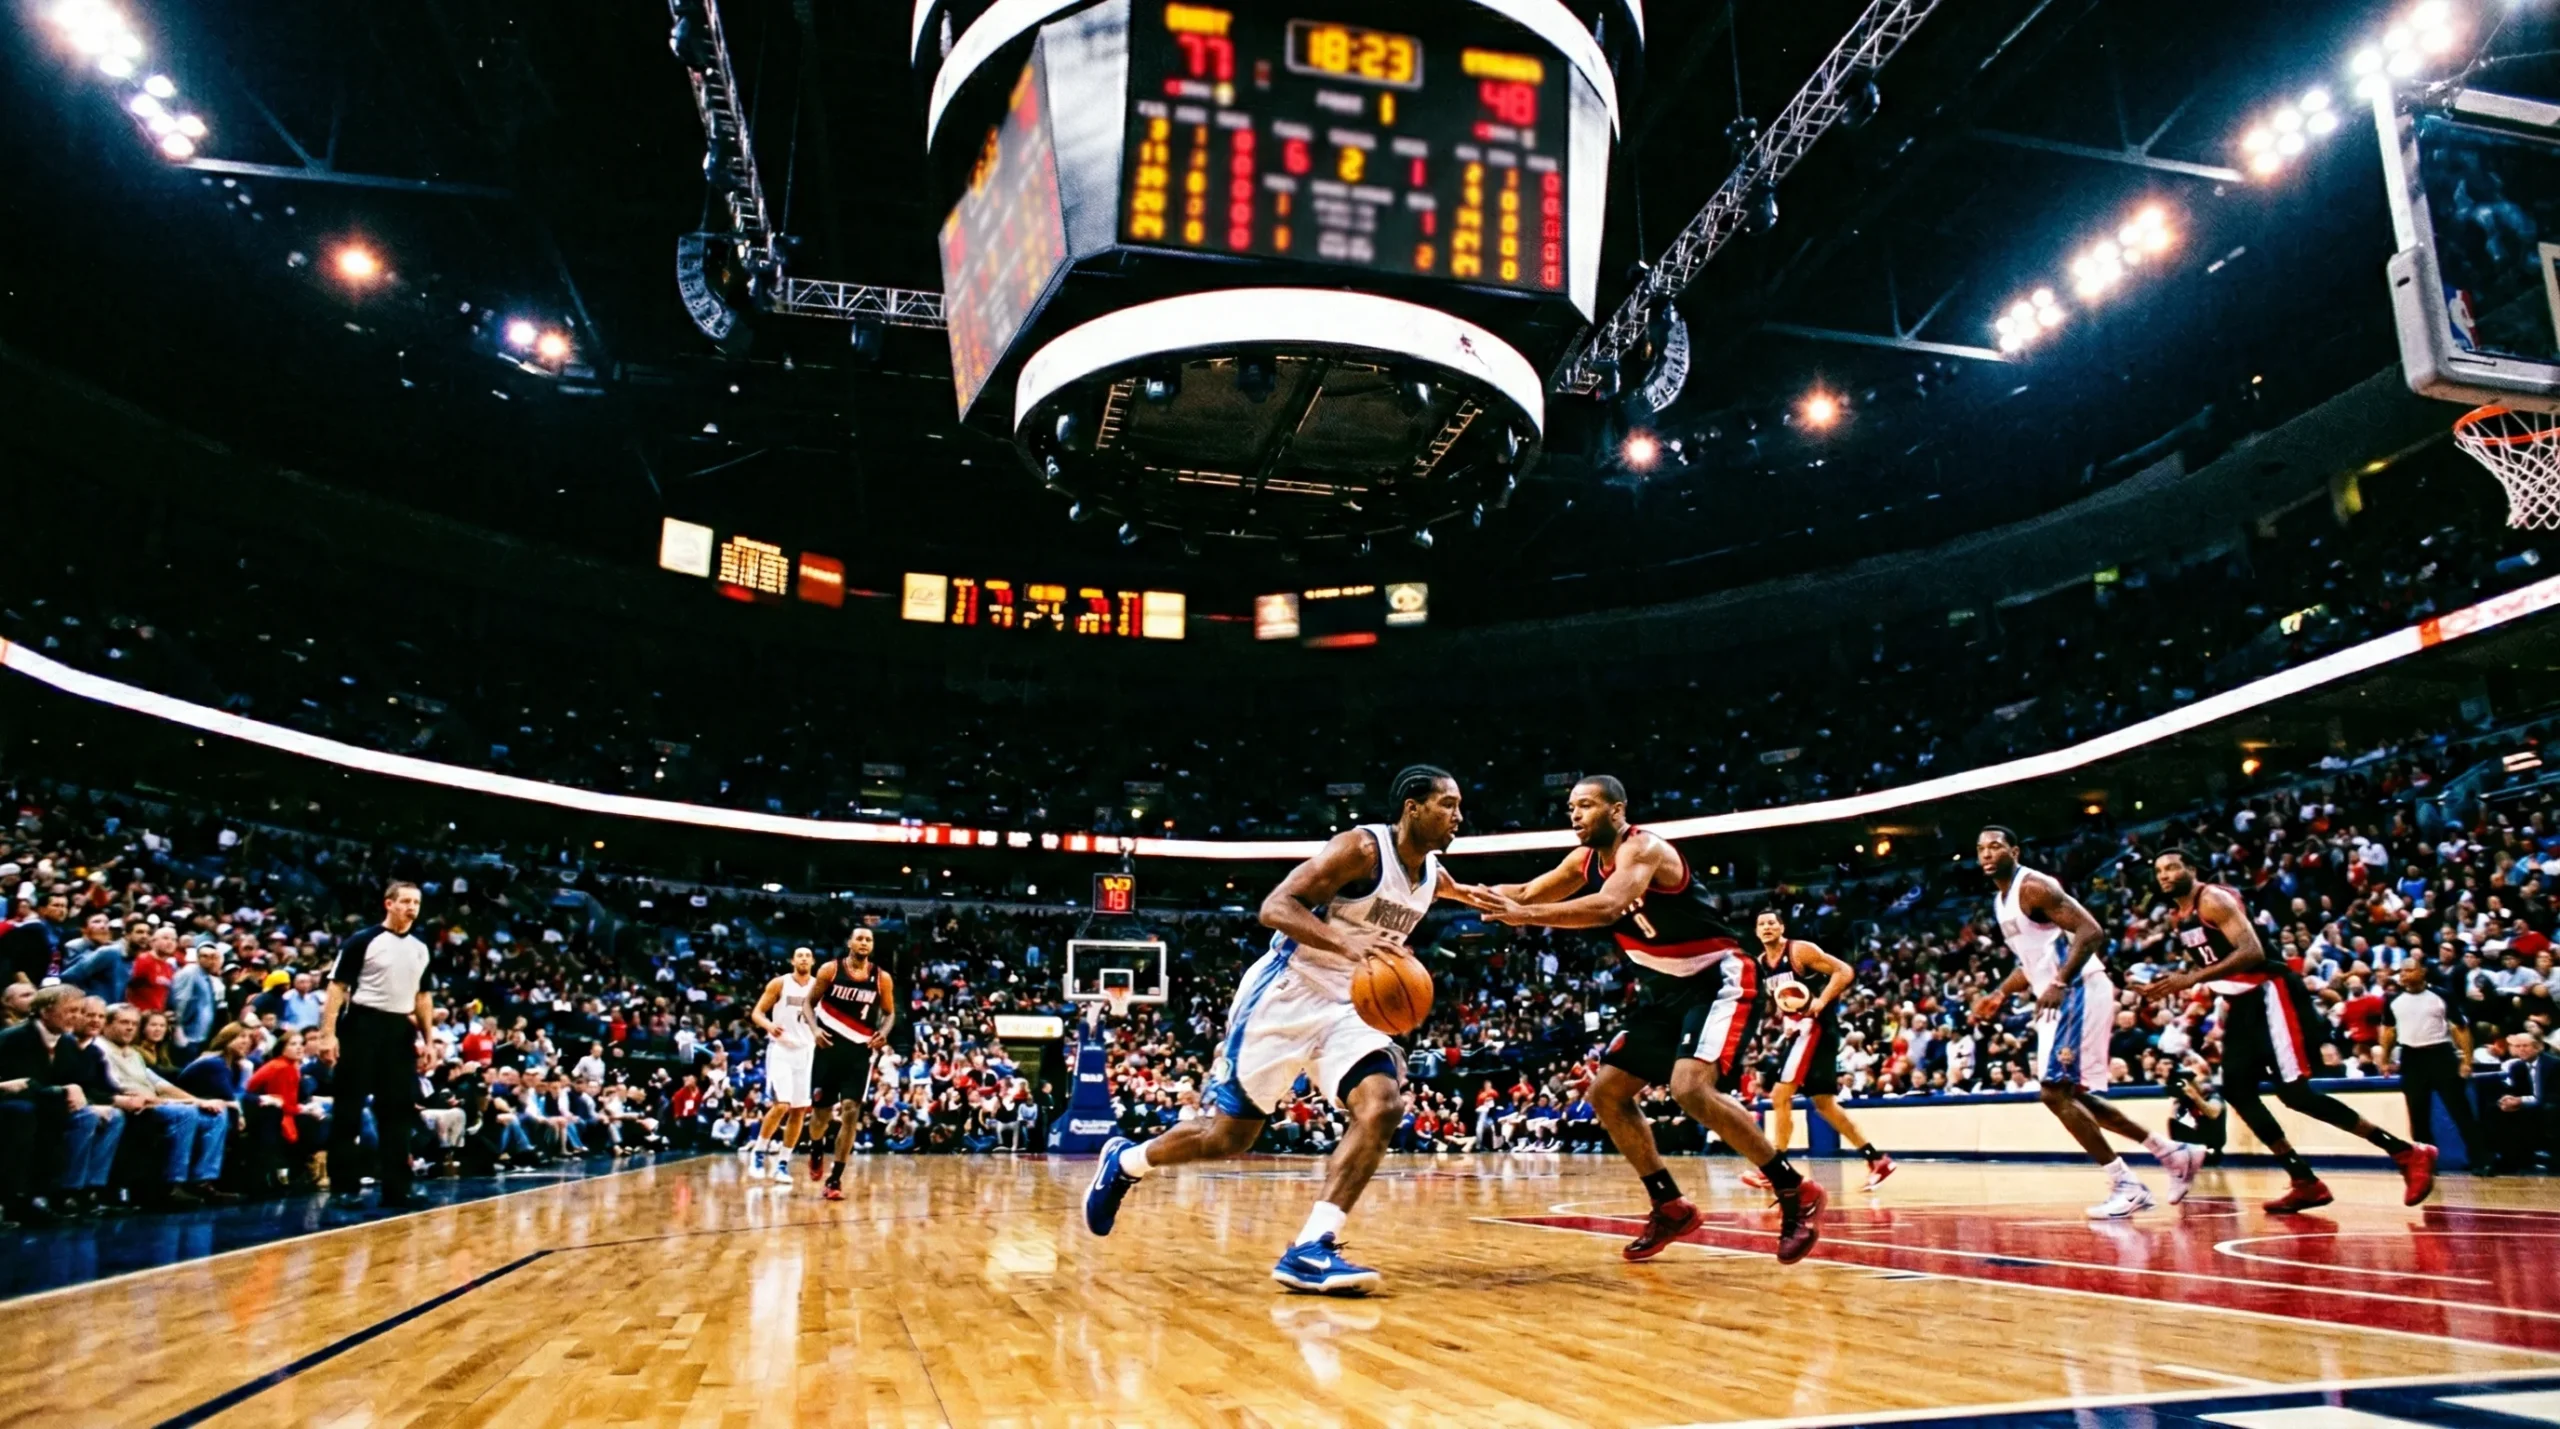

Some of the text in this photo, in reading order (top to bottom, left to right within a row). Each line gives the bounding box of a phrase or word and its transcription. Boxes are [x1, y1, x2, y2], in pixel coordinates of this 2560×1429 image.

[1178, 33, 1233, 80] 77
[1308, 25, 1413, 83] 18:23
[1479, 79, 1537, 126] 48
[1109, 890, 1126, 910] 18
